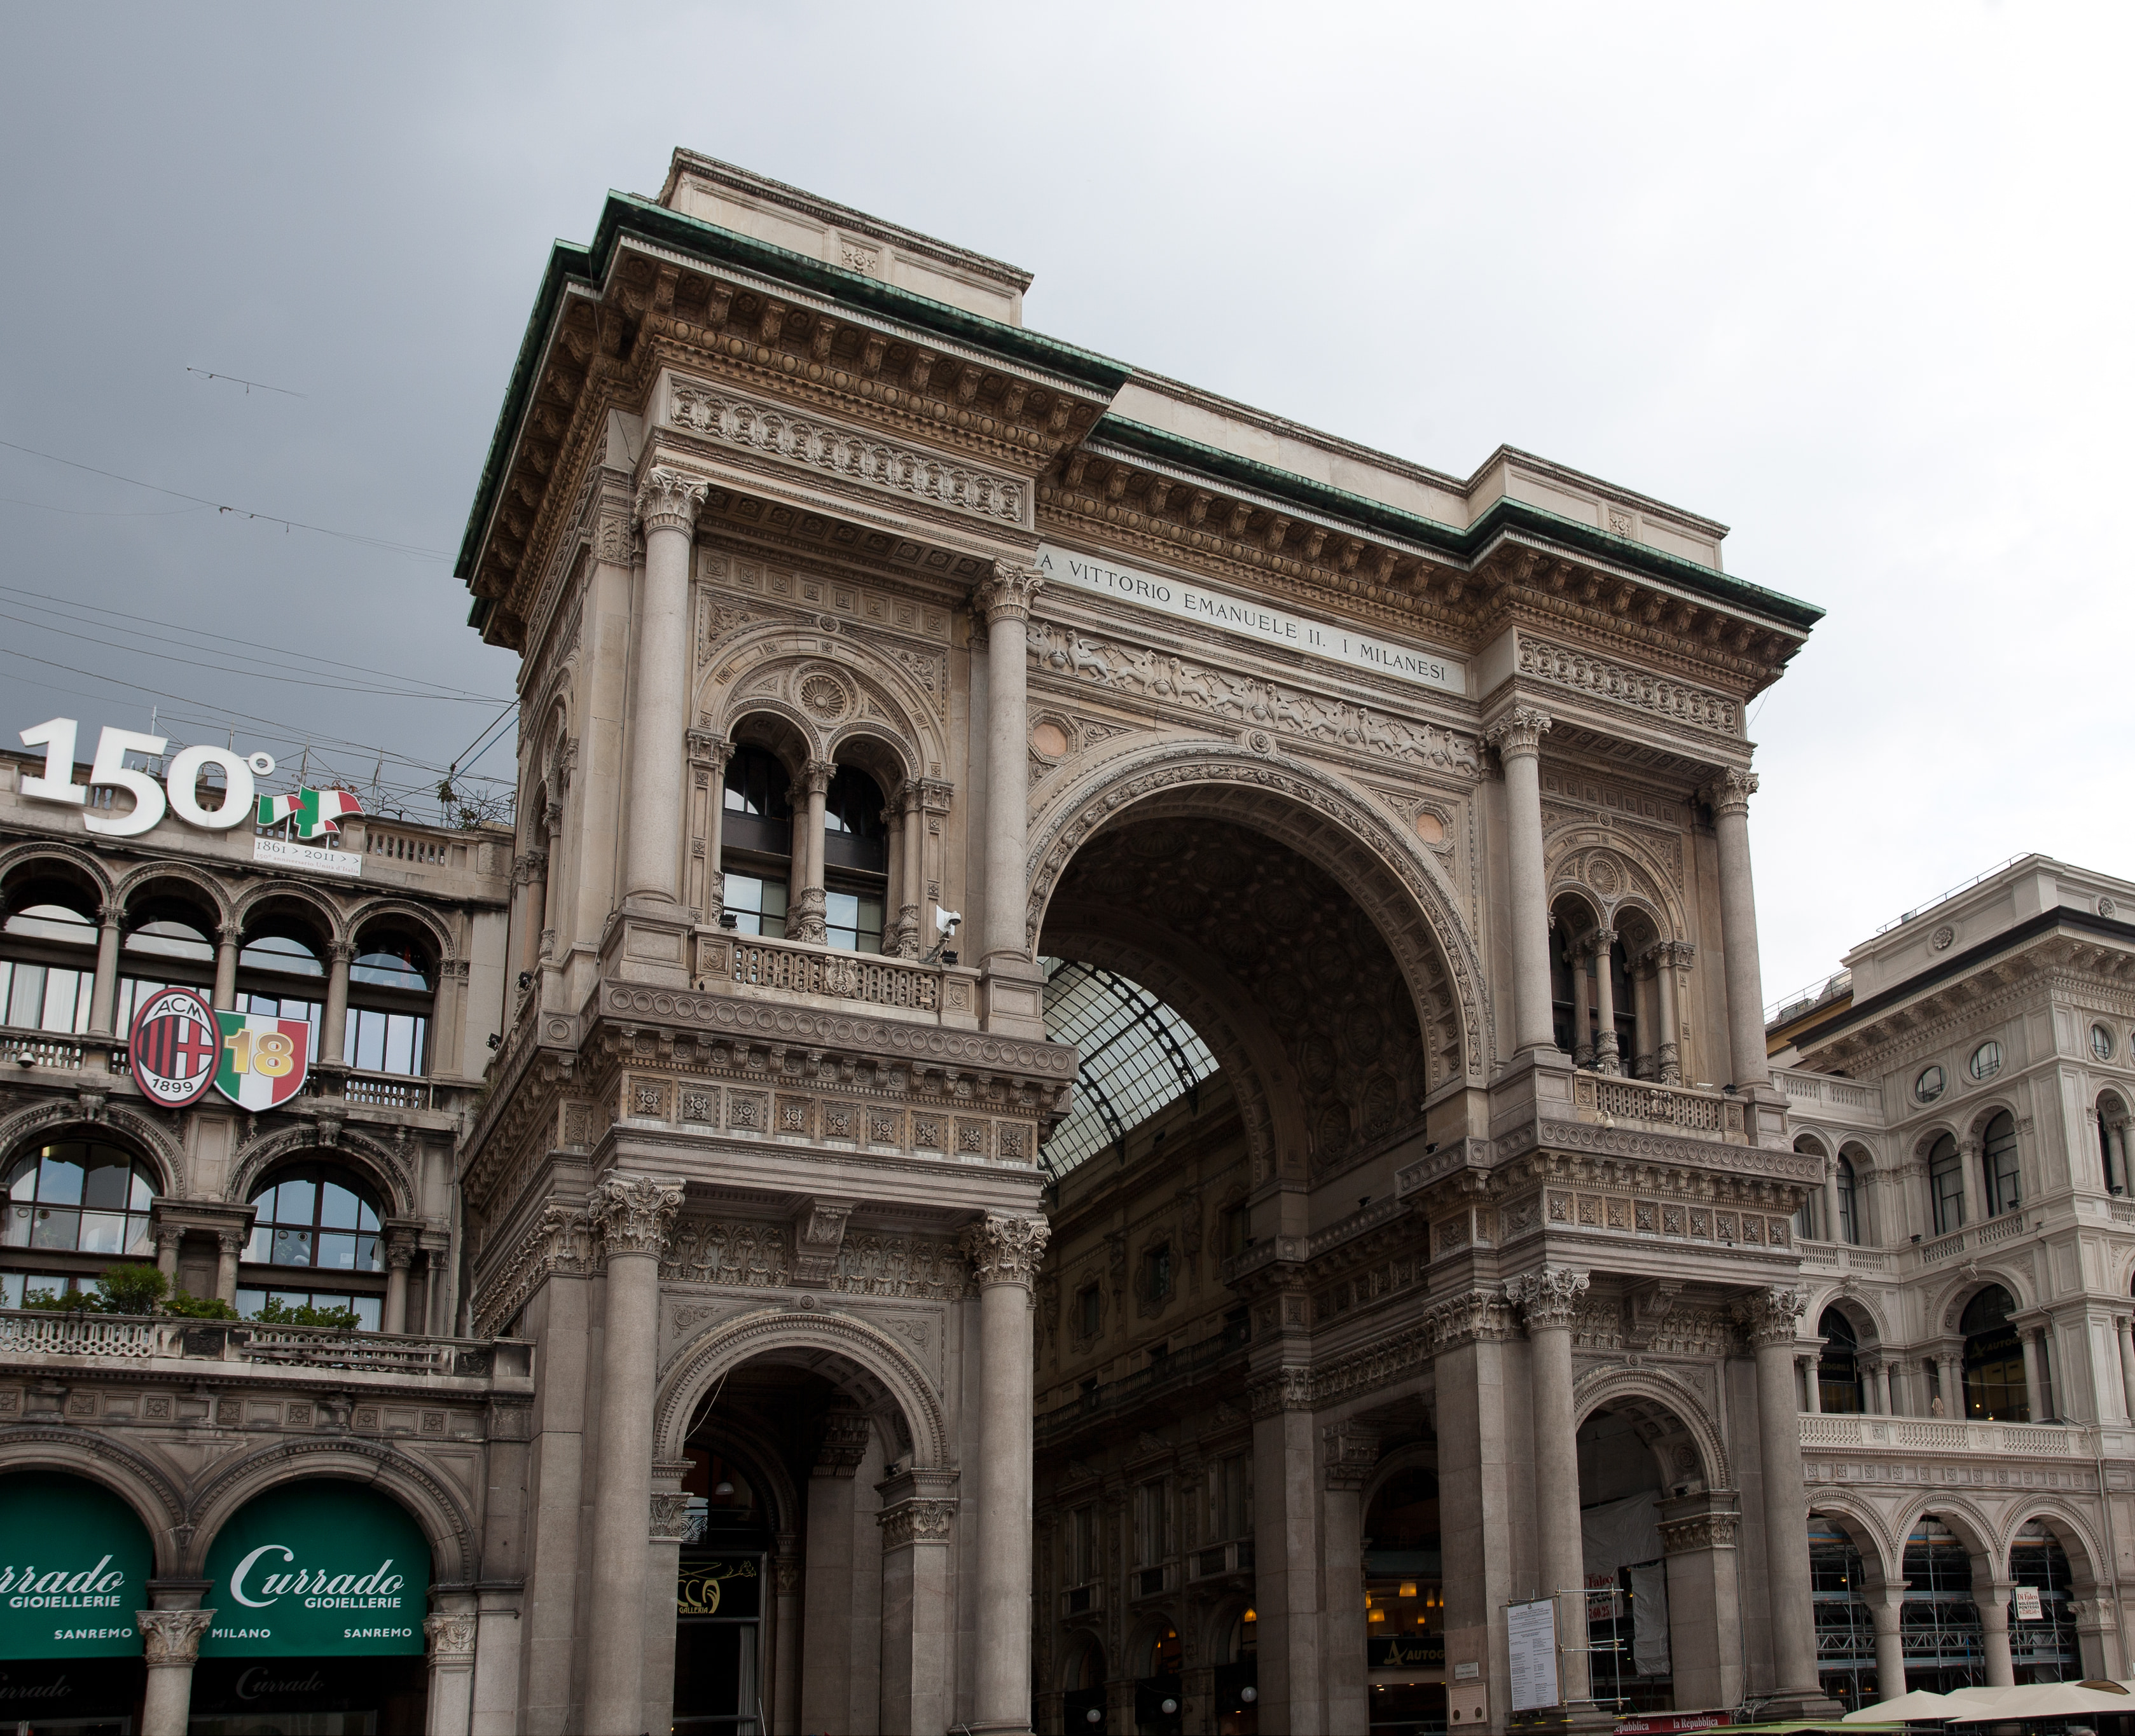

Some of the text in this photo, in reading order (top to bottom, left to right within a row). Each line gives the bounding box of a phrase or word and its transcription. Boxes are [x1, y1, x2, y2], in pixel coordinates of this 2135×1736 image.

[1040, 554, 1445, 680] A VITTORIO EMANUELE II. I MILANESI
[256, 841, 286, 853] 1861
[305, 850, 335, 862] 2011
[273, 856, 314, 867] anniversario
[316, 862, 335, 871] Unità
[153, 997, 203, 1022] ACM
[225, 1028, 294, 1078] 18
[152, 1078, 193, 1093] 1899
[230, 1544, 404, 1608] Currado
[9, 1595, 121, 1608] GIOIELLERIE
[304, 1597, 401, 1608] GIOIELLERIE
[53, 1628, 133, 1640] SANREMO
[211, 1628, 413, 1639] MILANO SANREMO
[235, 1666, 326, 1700] Currado
[1613, 1720, 1649, 1734] epubblica
[1673, 1716, 1718, 1730] la Repubblica
